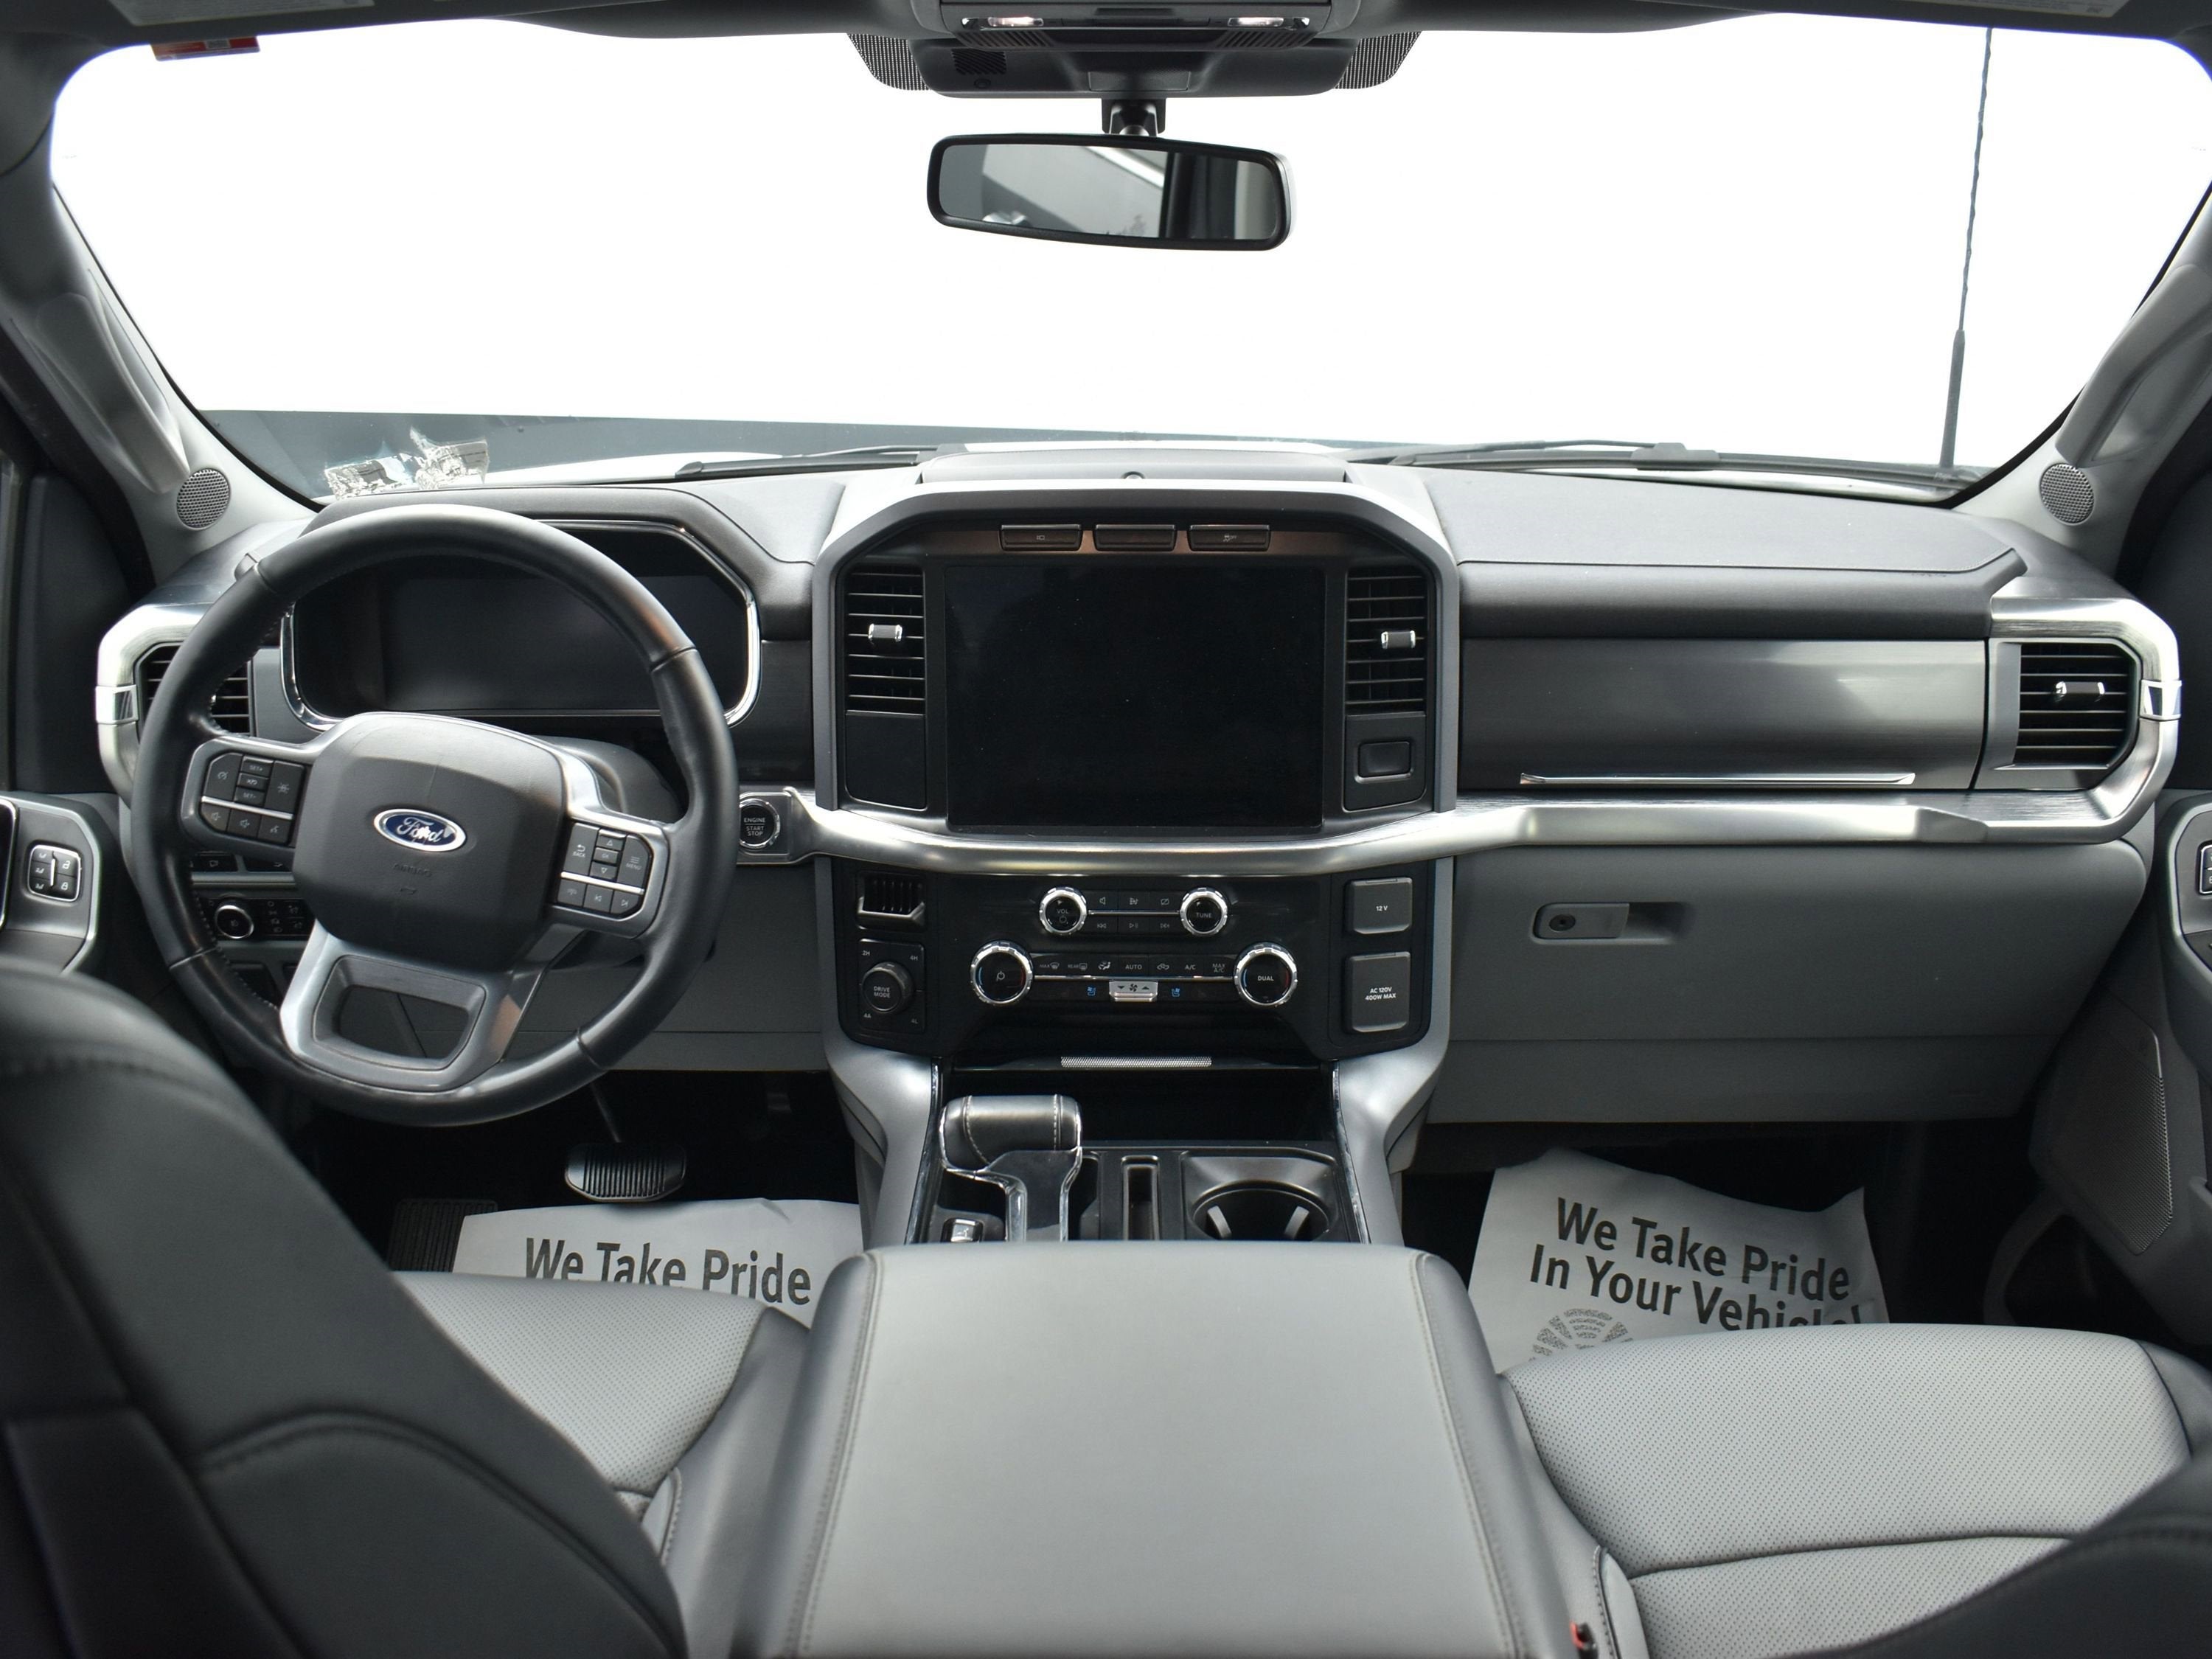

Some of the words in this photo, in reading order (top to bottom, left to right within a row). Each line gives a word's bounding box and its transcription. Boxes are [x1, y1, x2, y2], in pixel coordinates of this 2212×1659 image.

[397, 817, 444, 842] Ford
[526, 1237, 584, 1281] We
[596, 1242, 686, 1287] Take
[702, 1249, 811, 1306] Pride
[1529, 1243, 1571, 1290] In
[1585, 1255, 1682, 1315] Your
[1691, 1280, 1862, 1332] Vehi
[1557, 1197, 1618, 1251] We
[1631, 1216, 1727, 1276] Take
[1742, 1244, 1850, 1301] Pride
